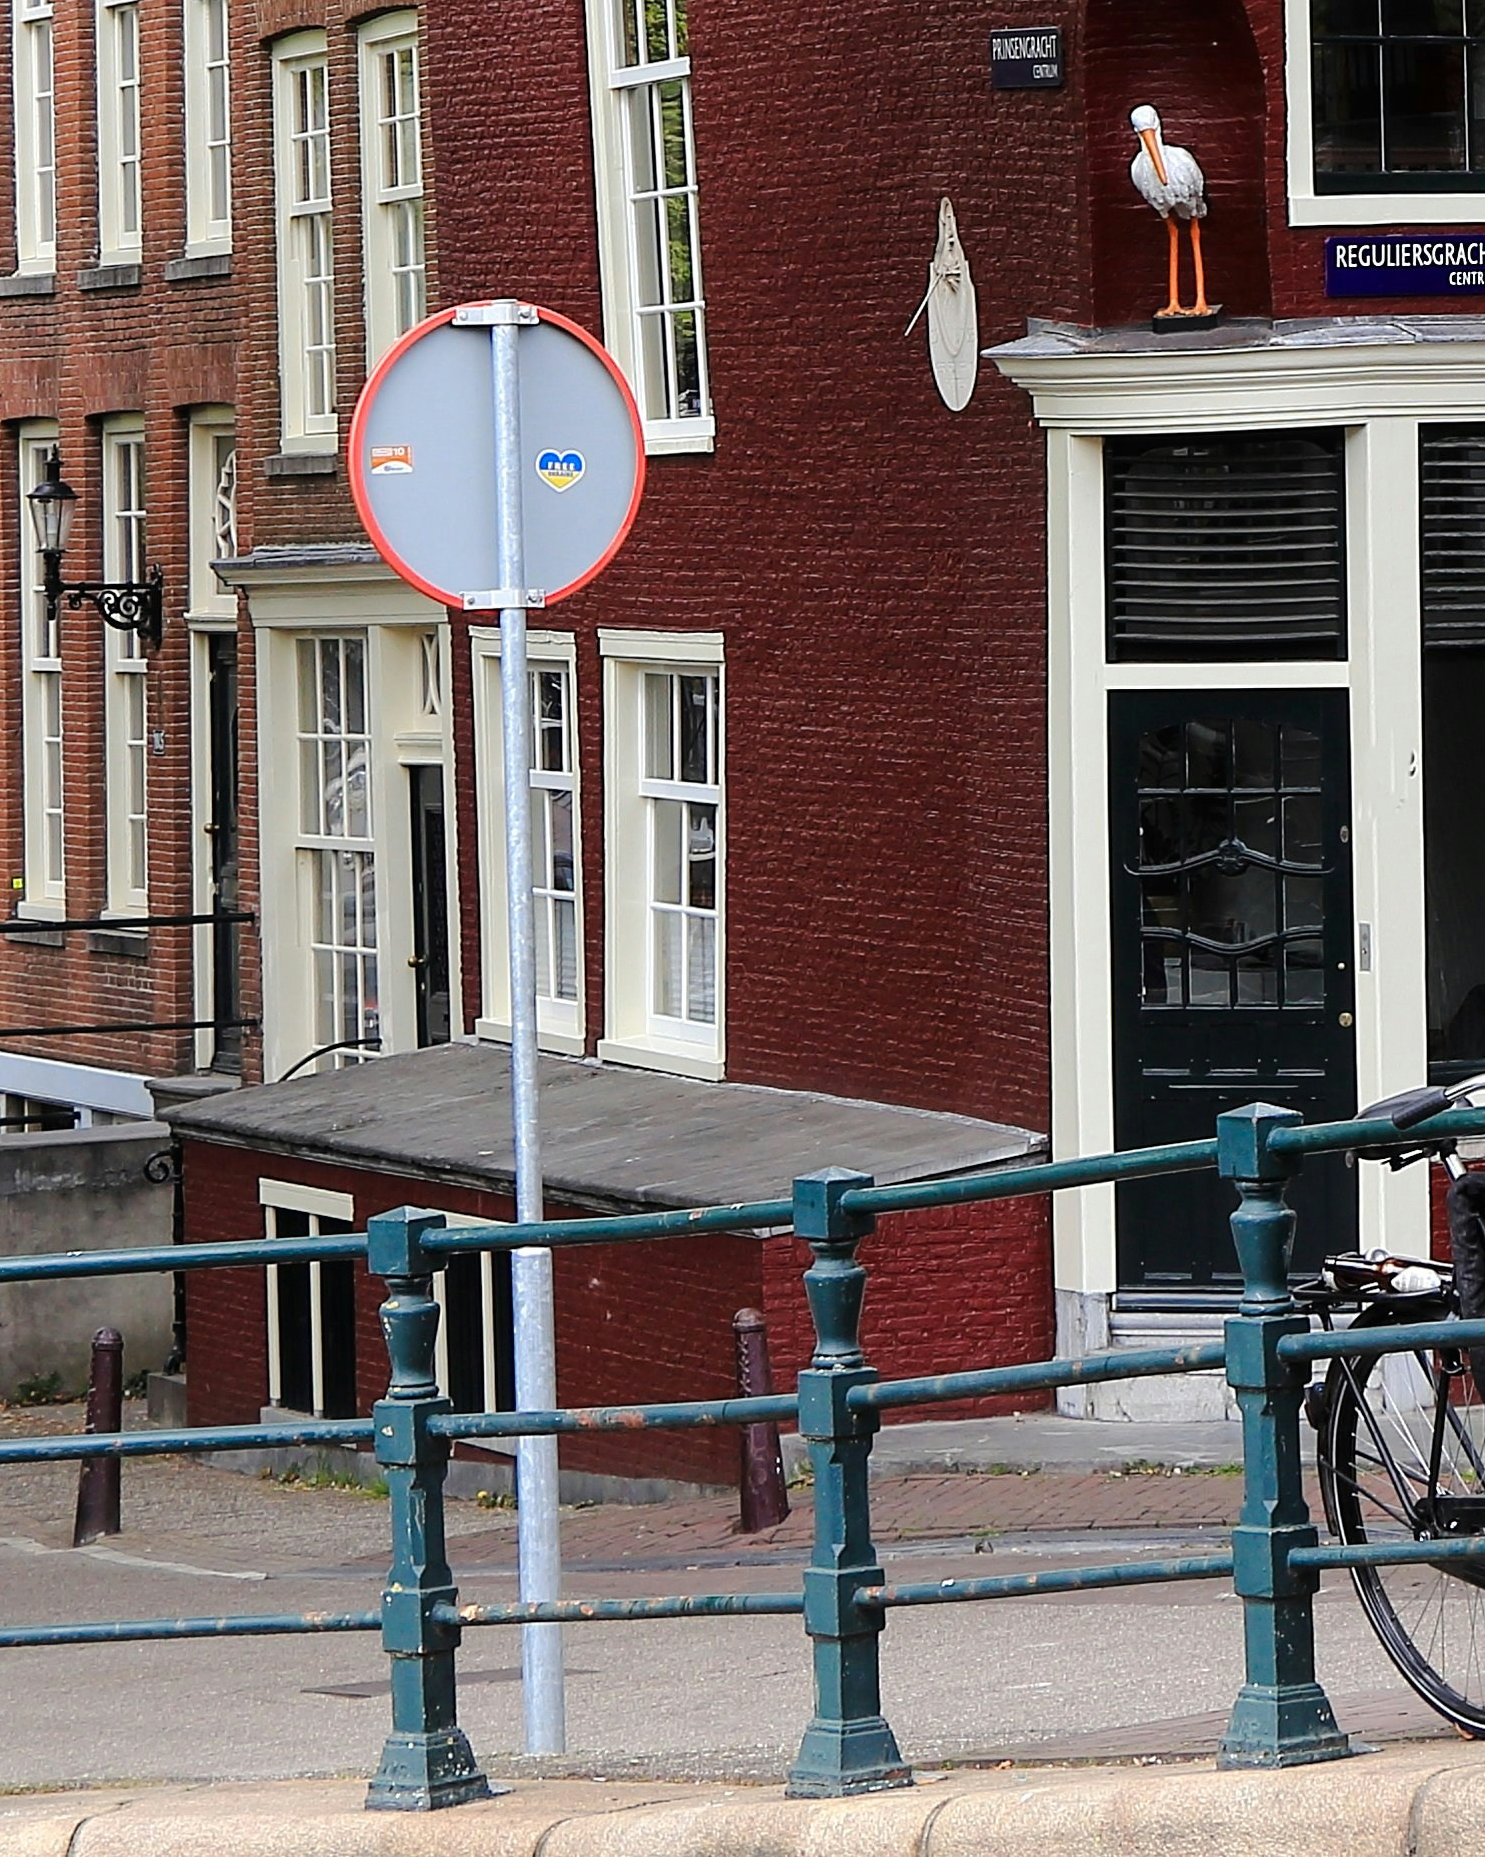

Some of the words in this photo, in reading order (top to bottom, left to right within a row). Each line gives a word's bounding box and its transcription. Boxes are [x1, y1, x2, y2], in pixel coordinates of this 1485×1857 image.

[992, 35, 1057, 61] PRINSENGRACHT
[1033, 64, 1058, 79] CENTRUM
[547, 461, 576, 471] FREE
